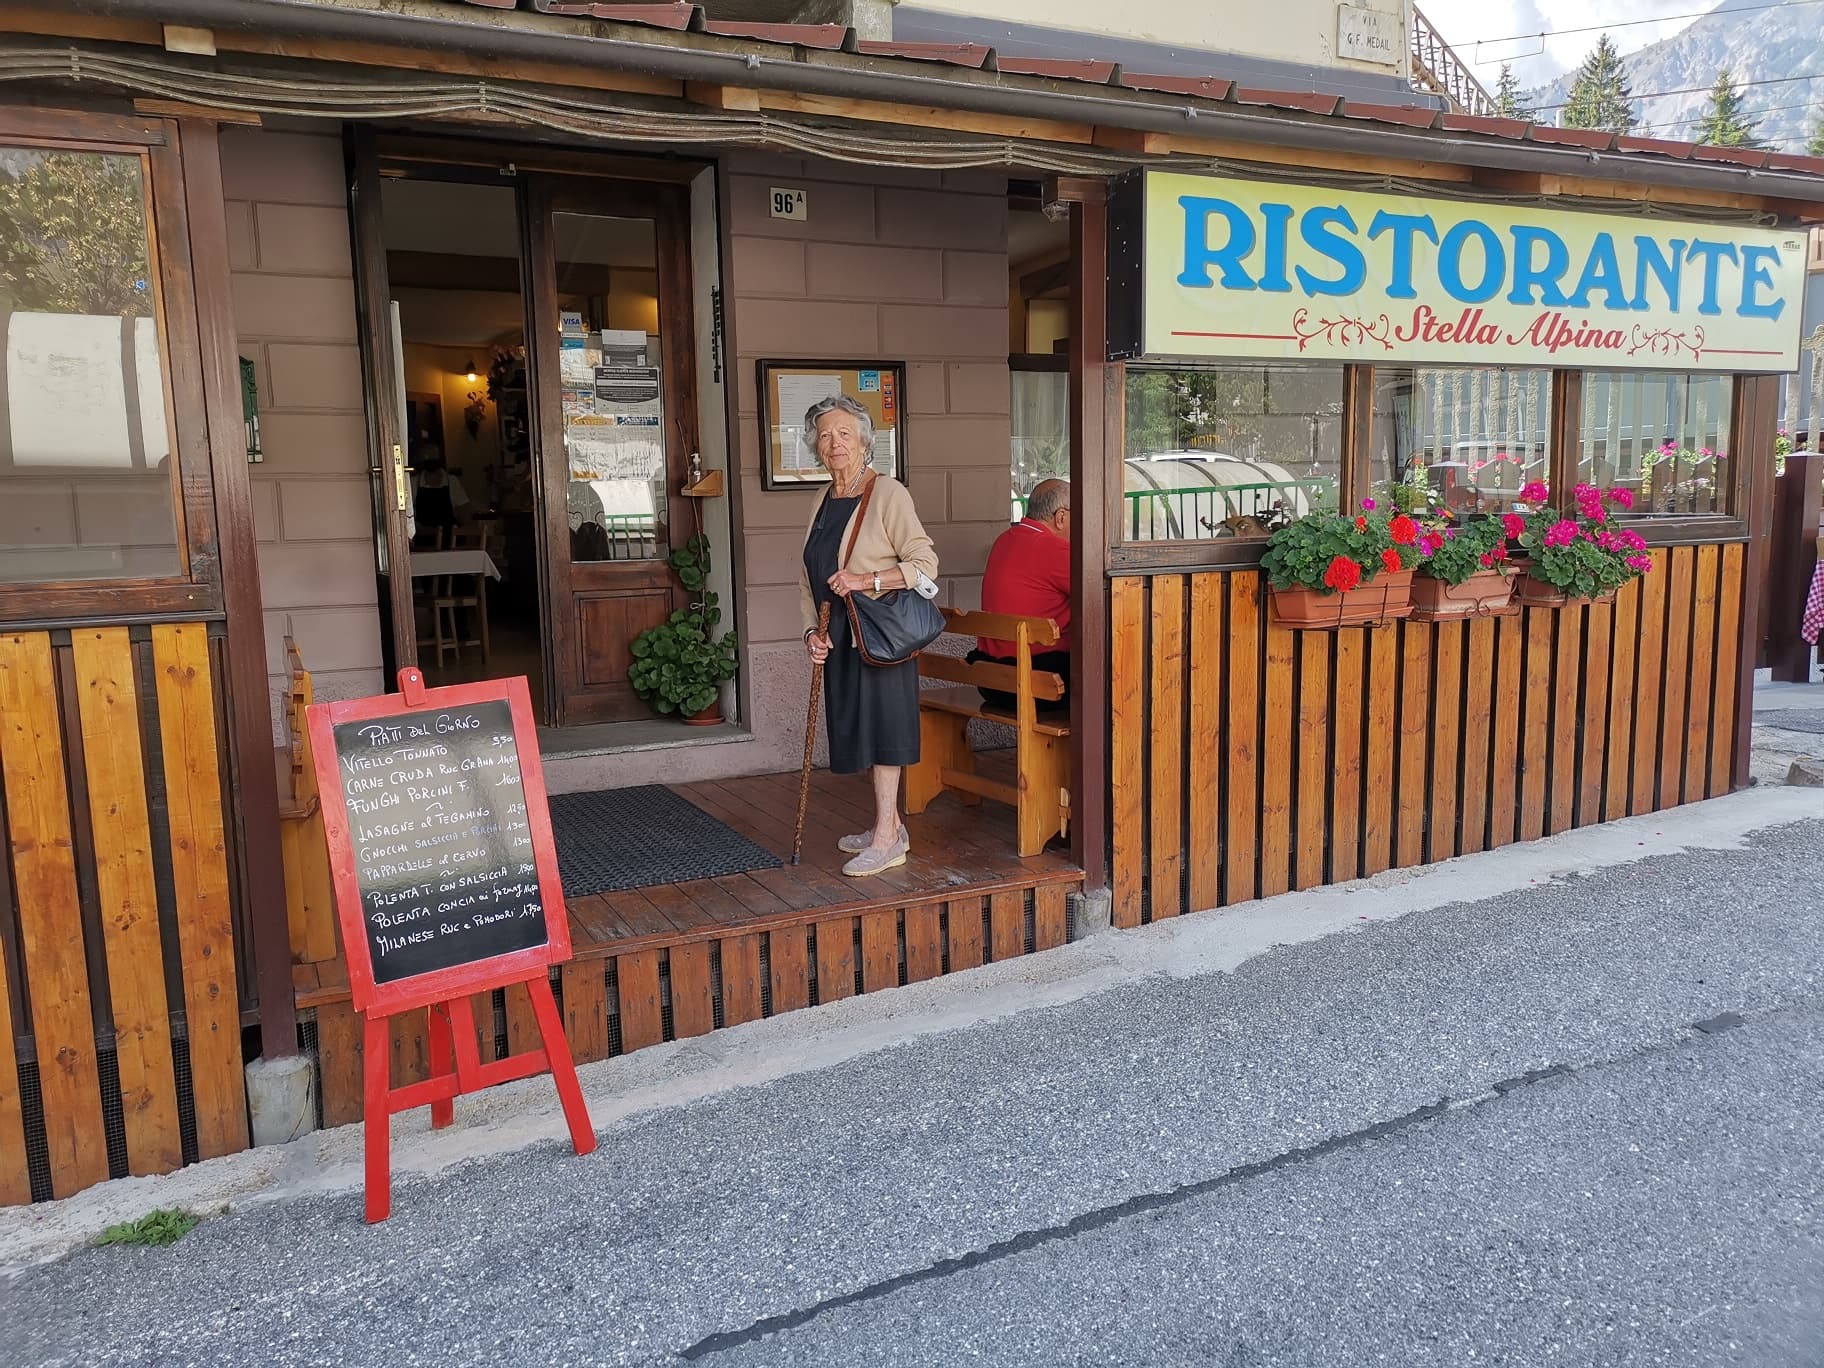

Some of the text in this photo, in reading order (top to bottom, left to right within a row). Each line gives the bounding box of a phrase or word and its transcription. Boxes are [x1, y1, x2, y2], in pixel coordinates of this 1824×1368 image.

[1362, 16, 1377, 26] VIA
[1177, 194, 1786, 323] RISTORANTE
[1394, 305, 1627, 354] Stella Alpina
[358, 714, 480, 746] PIATTI DEL GIORNO
[342, 753, 394, 775] VITELLO
[393, 744, 448, 761] TONNATO
[347, 776, 384, 795] CARNE
[390, 767, 434, 785] CRUDA
[460, 756, 494, 771] GRANA
[346, 792, 400, 815] FUNGHI
[406, 784, 453, 803] PORCINI
[358, 821, 415, 844] LASAGNE
[434, 807, 490, 825] TEGAMINO
[360, 844, 408, 863] GNOCCHI
[414, 832, 458, 848] SALSICCIA
[362, 857, 433, 881] PAPPARDELLE
[452, 848, 486, 862] CERVO
[367, 887, 420, 908] POLENTA
[440, 882, 456, 892] CON
[458, 866, 508, 888] SALSICCIA
[371, 906, 431, 929] POLENTA
[438, 896, 476, 912] CONCIA
[376, 930, 435, 957] MILANESE
[472, 908, 515, 926] POMODORI
